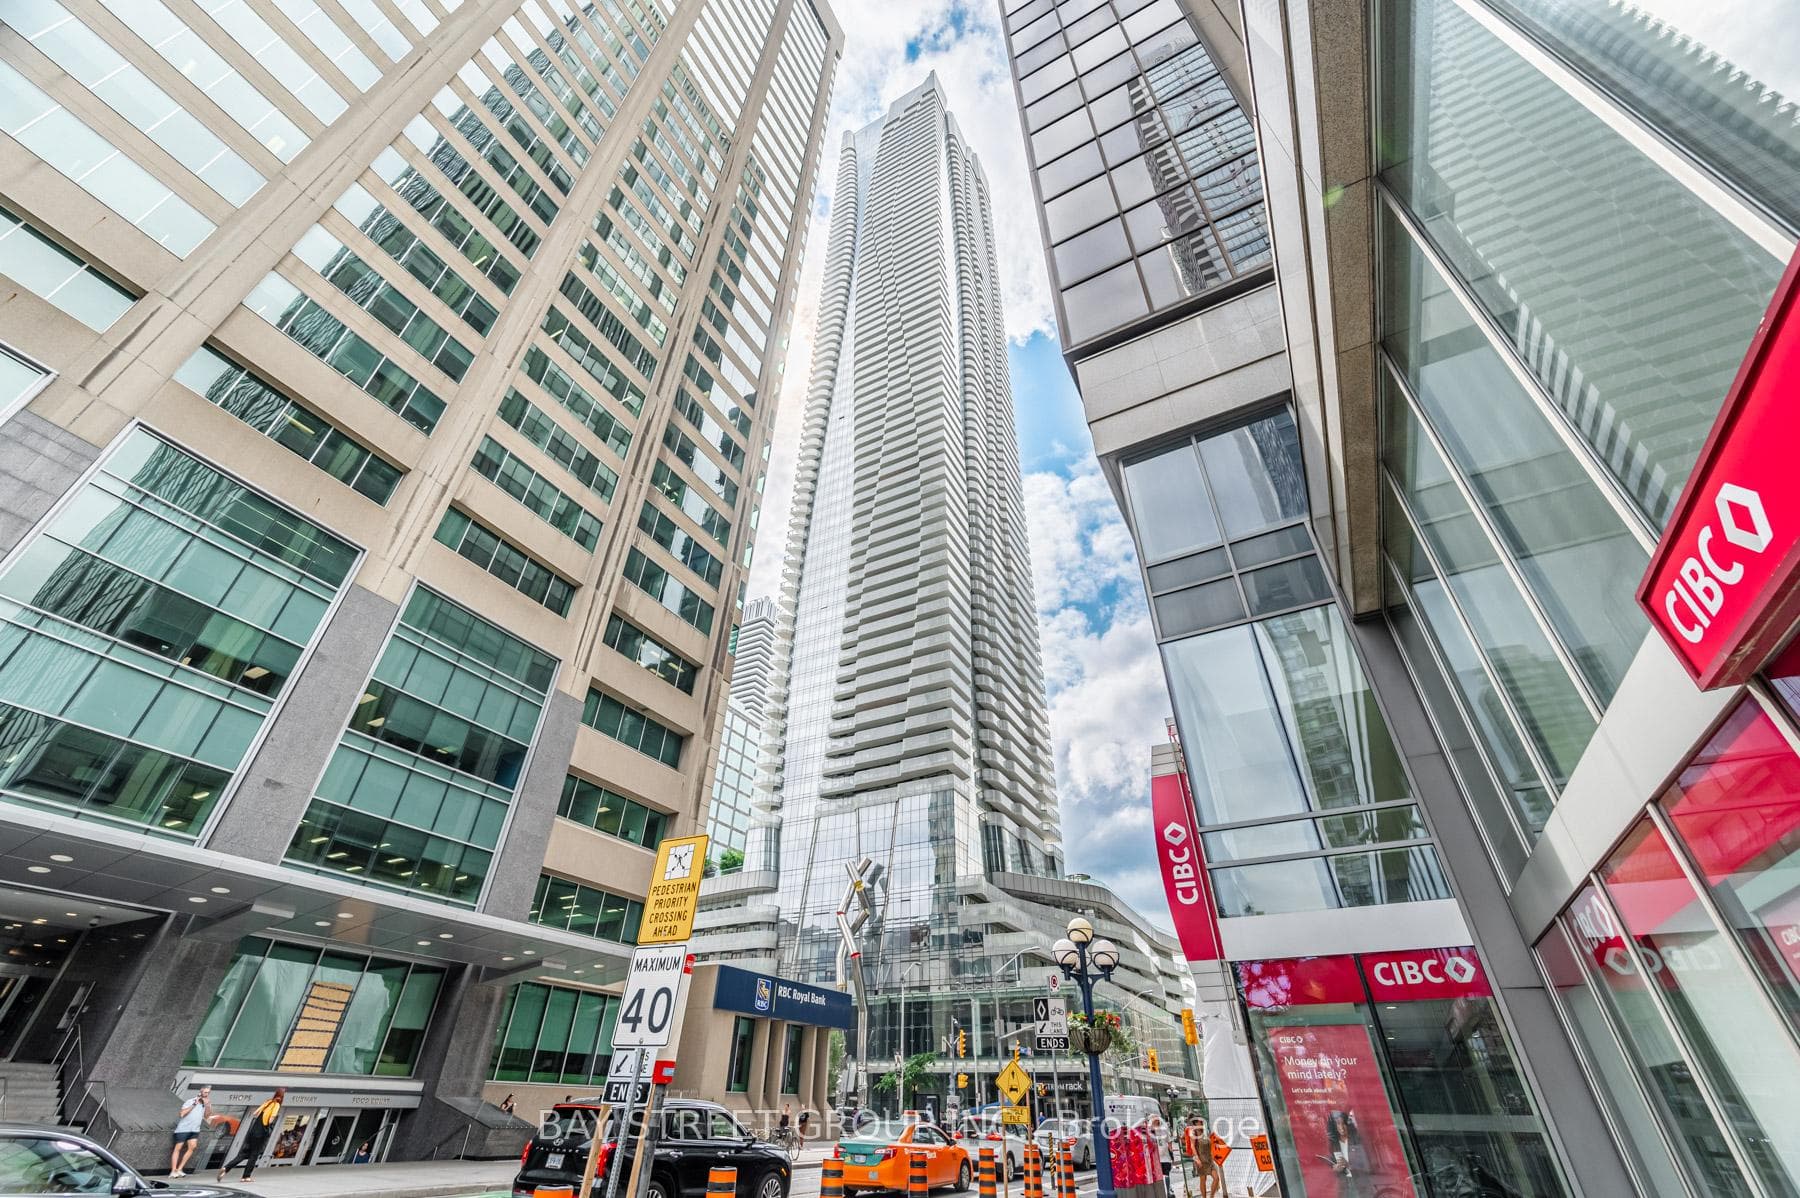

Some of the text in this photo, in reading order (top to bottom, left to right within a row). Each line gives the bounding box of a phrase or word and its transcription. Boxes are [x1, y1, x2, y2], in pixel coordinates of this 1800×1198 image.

[1665, 525, 1744, 644] CIBC
[1169, 846, 1199, 905] CIBC
[652, 882, 697, 896] PEDESTRIAN
[653, 896, 689, 910] PRIORITY
[649, 910, 688, 924] CROSSING
[652, 925, 678, 937] AHEAD
[634, 956, 681, 973] MAXIMUM
[1374, 959, 1446, 986] CIBC
[778, 985, 826, 1006] RBC Royal Bank
[621, 987, 673, 1034] 40
[757, 1000, 769, 1008] RBC
[1041, 1038, 1065, 1048] ENDS
[1280, 1036, 1297, 1044] CIBC
[1284, 1056, 1317, 1067] Money
[1335, 1057, 1358, 1067] your
[1288, 1068, 1347, 1081] mind lately?
[609, 1084, 643, 1101] ENS
[1065, 1081, 1083, 1090] rack
